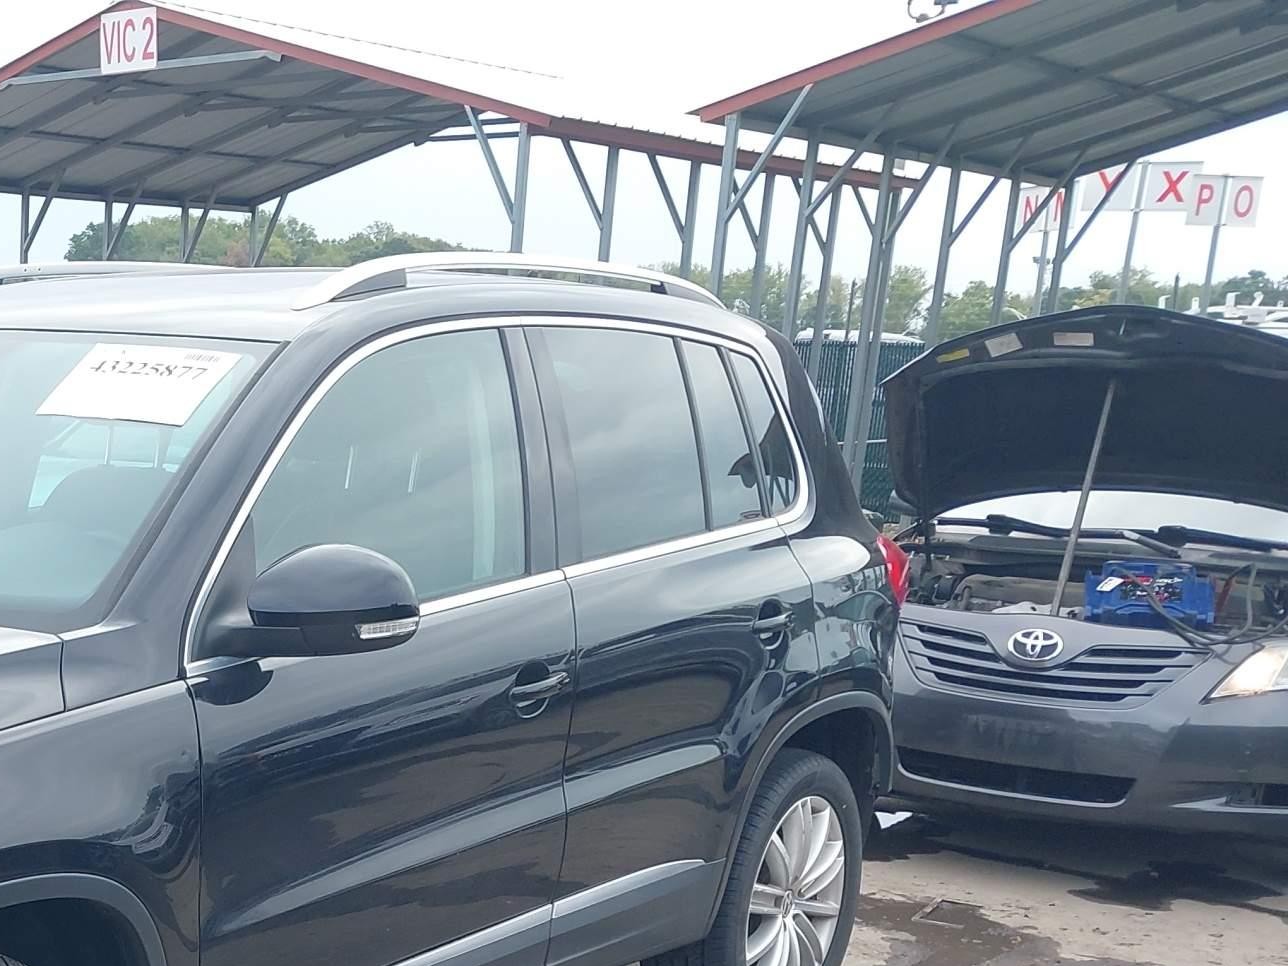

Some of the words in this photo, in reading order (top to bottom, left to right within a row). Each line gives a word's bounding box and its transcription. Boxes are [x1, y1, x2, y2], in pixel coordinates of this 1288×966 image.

[103, 18, 137, 65] VIC
[142, 16, 155, 61] 2
[1156, 170, 1190, 203] X
[1195, 183, 1213, 217] P
[1234, 184, 1254, 218] O
[90, 360, 210, 380] 43225877
